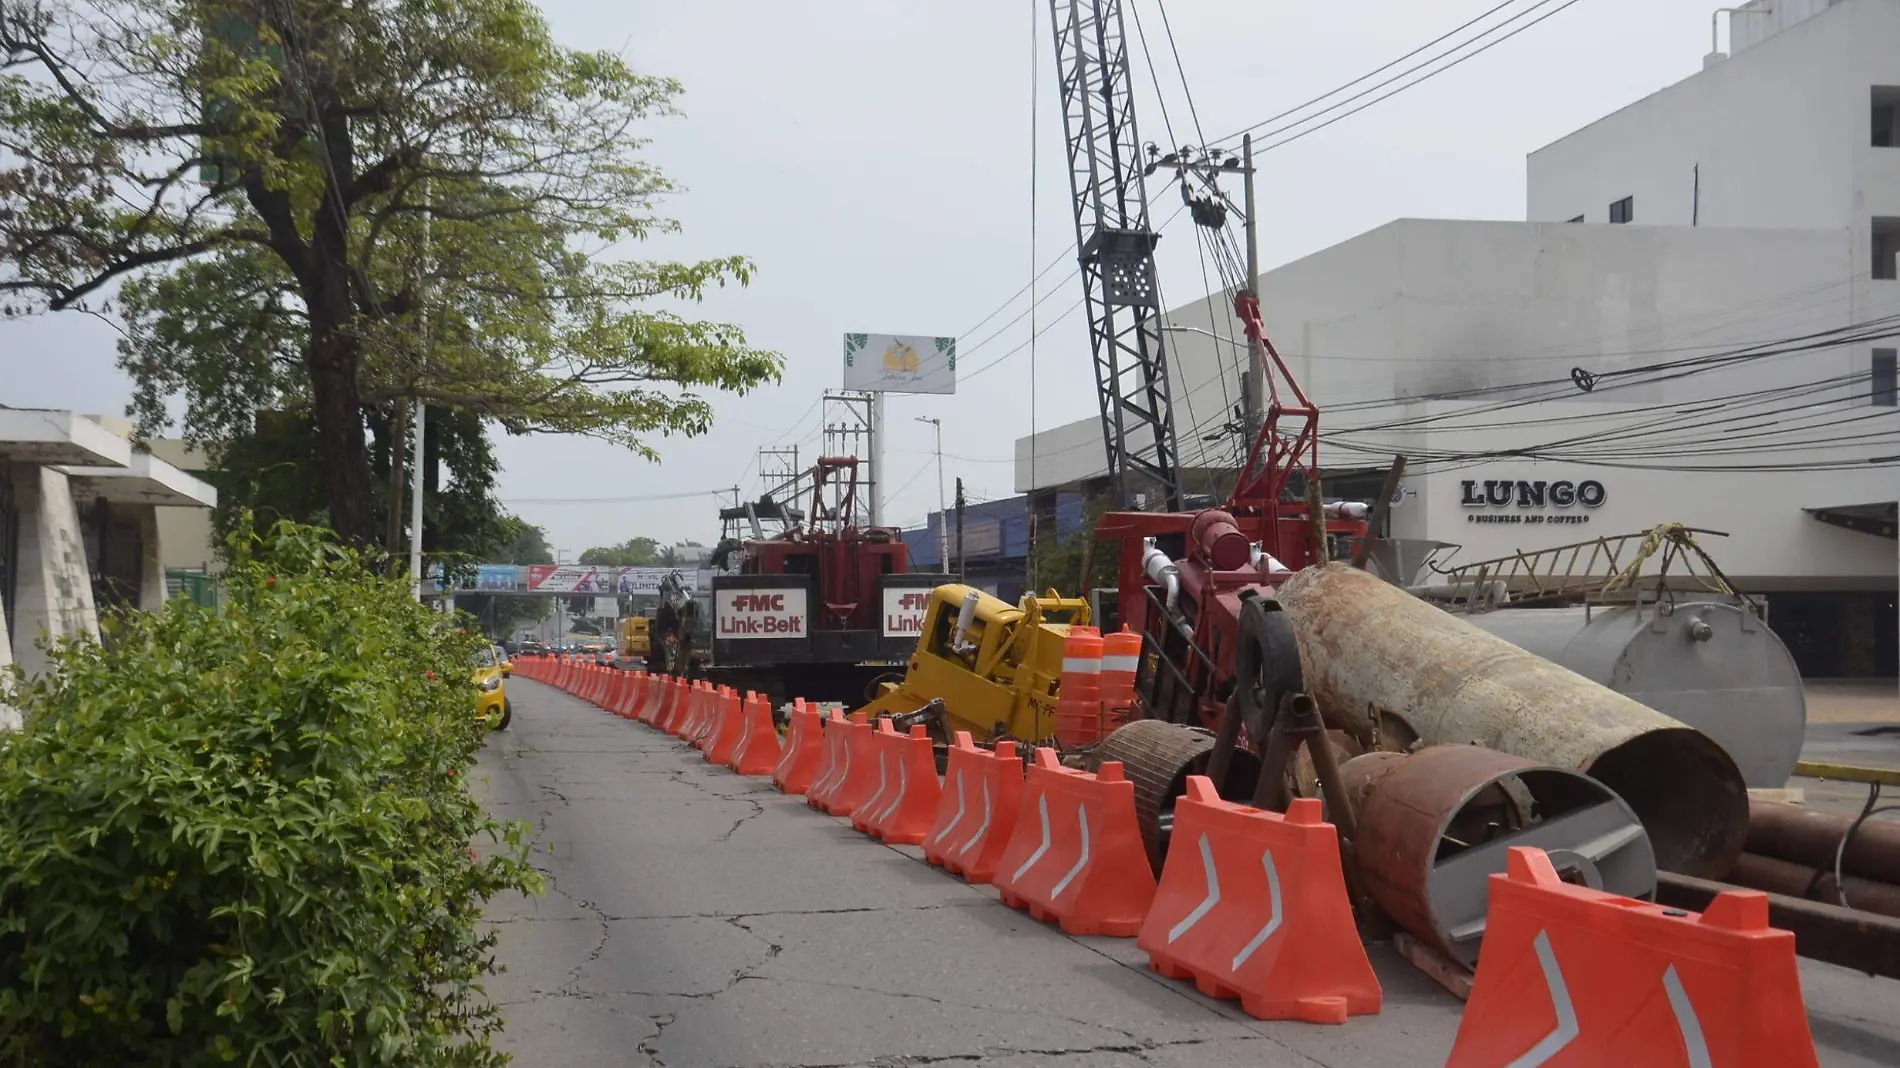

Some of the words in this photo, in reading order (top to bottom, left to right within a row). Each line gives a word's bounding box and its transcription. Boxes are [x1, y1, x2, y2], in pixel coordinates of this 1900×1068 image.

[1461, 480, 1607, 508] LUNGO
[1475, 515, 1521, 524] BUSINESS
[1525, 515, 1544, 524] AND
[1547, 516, 1584, 524] COFFEE
[732, 594, 784, 612] FMC
[898, 593, 929, 610] FM
[721, 615, 801, 633] Link-Belt
[888, 614, 924, 632] Link
